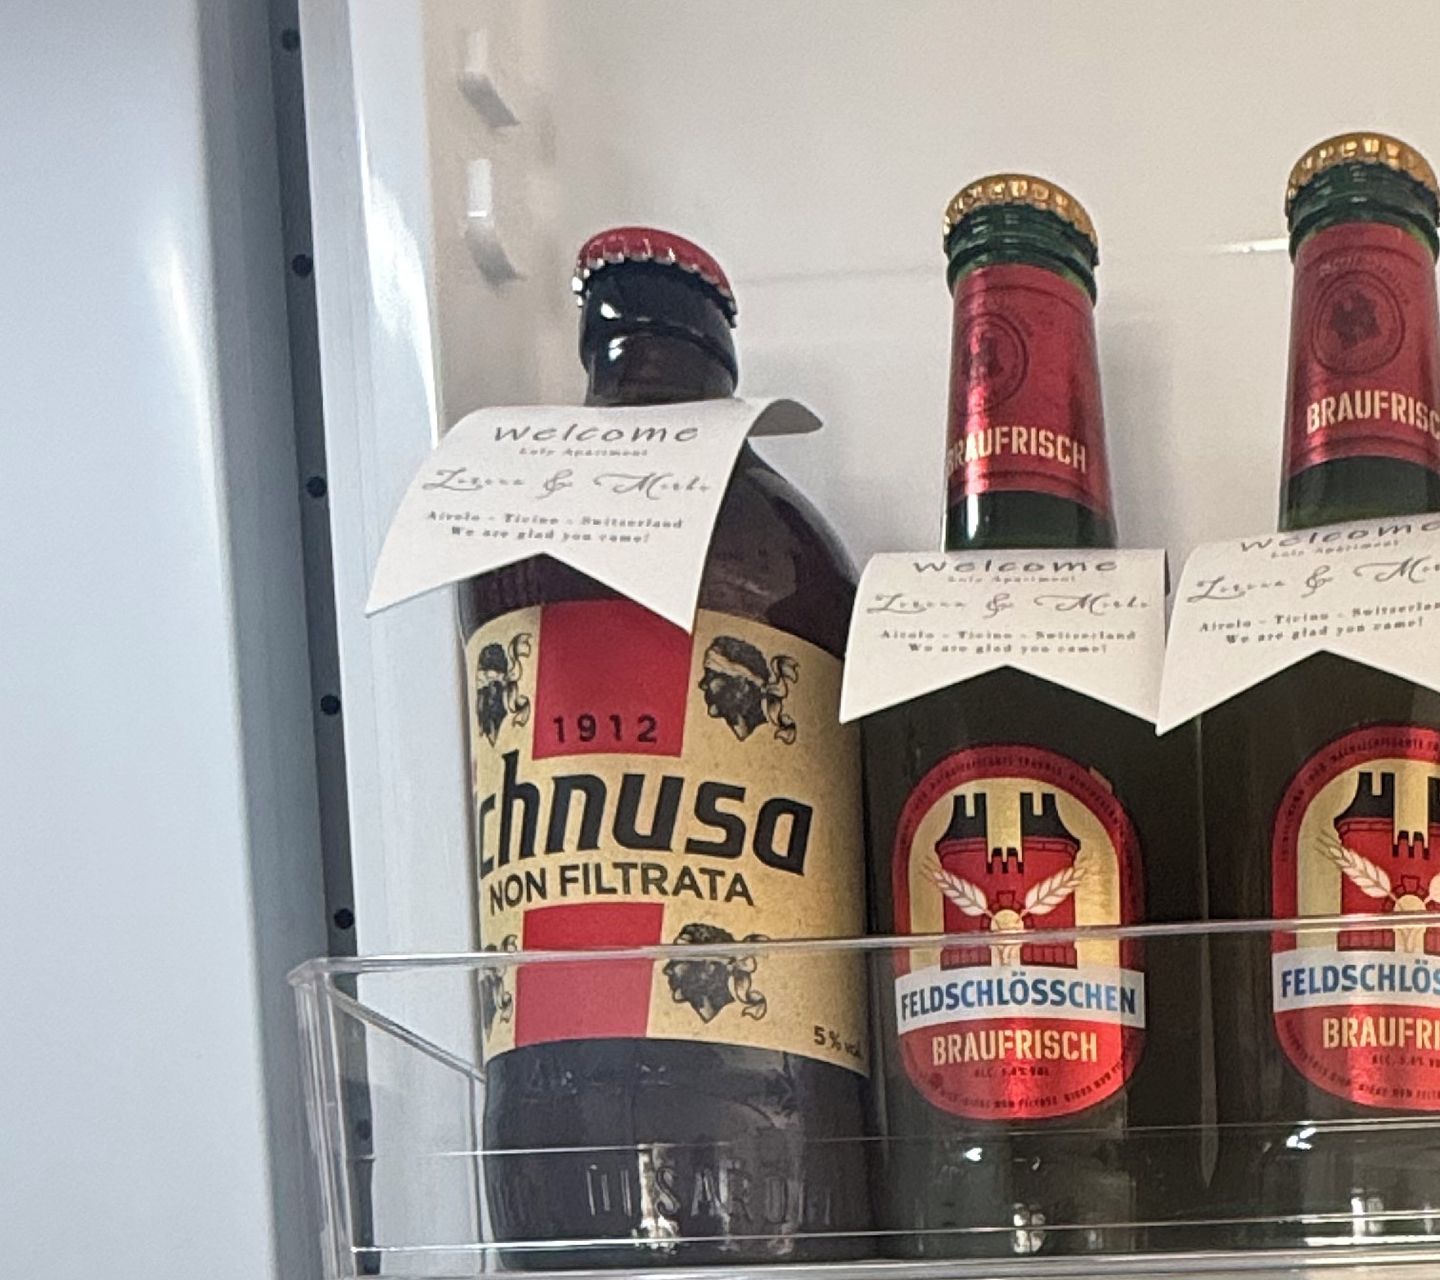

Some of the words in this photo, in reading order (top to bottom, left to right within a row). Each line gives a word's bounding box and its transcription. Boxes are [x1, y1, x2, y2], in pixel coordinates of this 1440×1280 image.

[552, 714, 658, 744] 1912
[488, 868, 546, 915] NON
[559, 862, 756, 907] FILTRATA
[901, 971, 1137, 1021] FELDSCHLÖSSCHEN
[931, 1029, 1099, 1066] BRAUFRISCH
